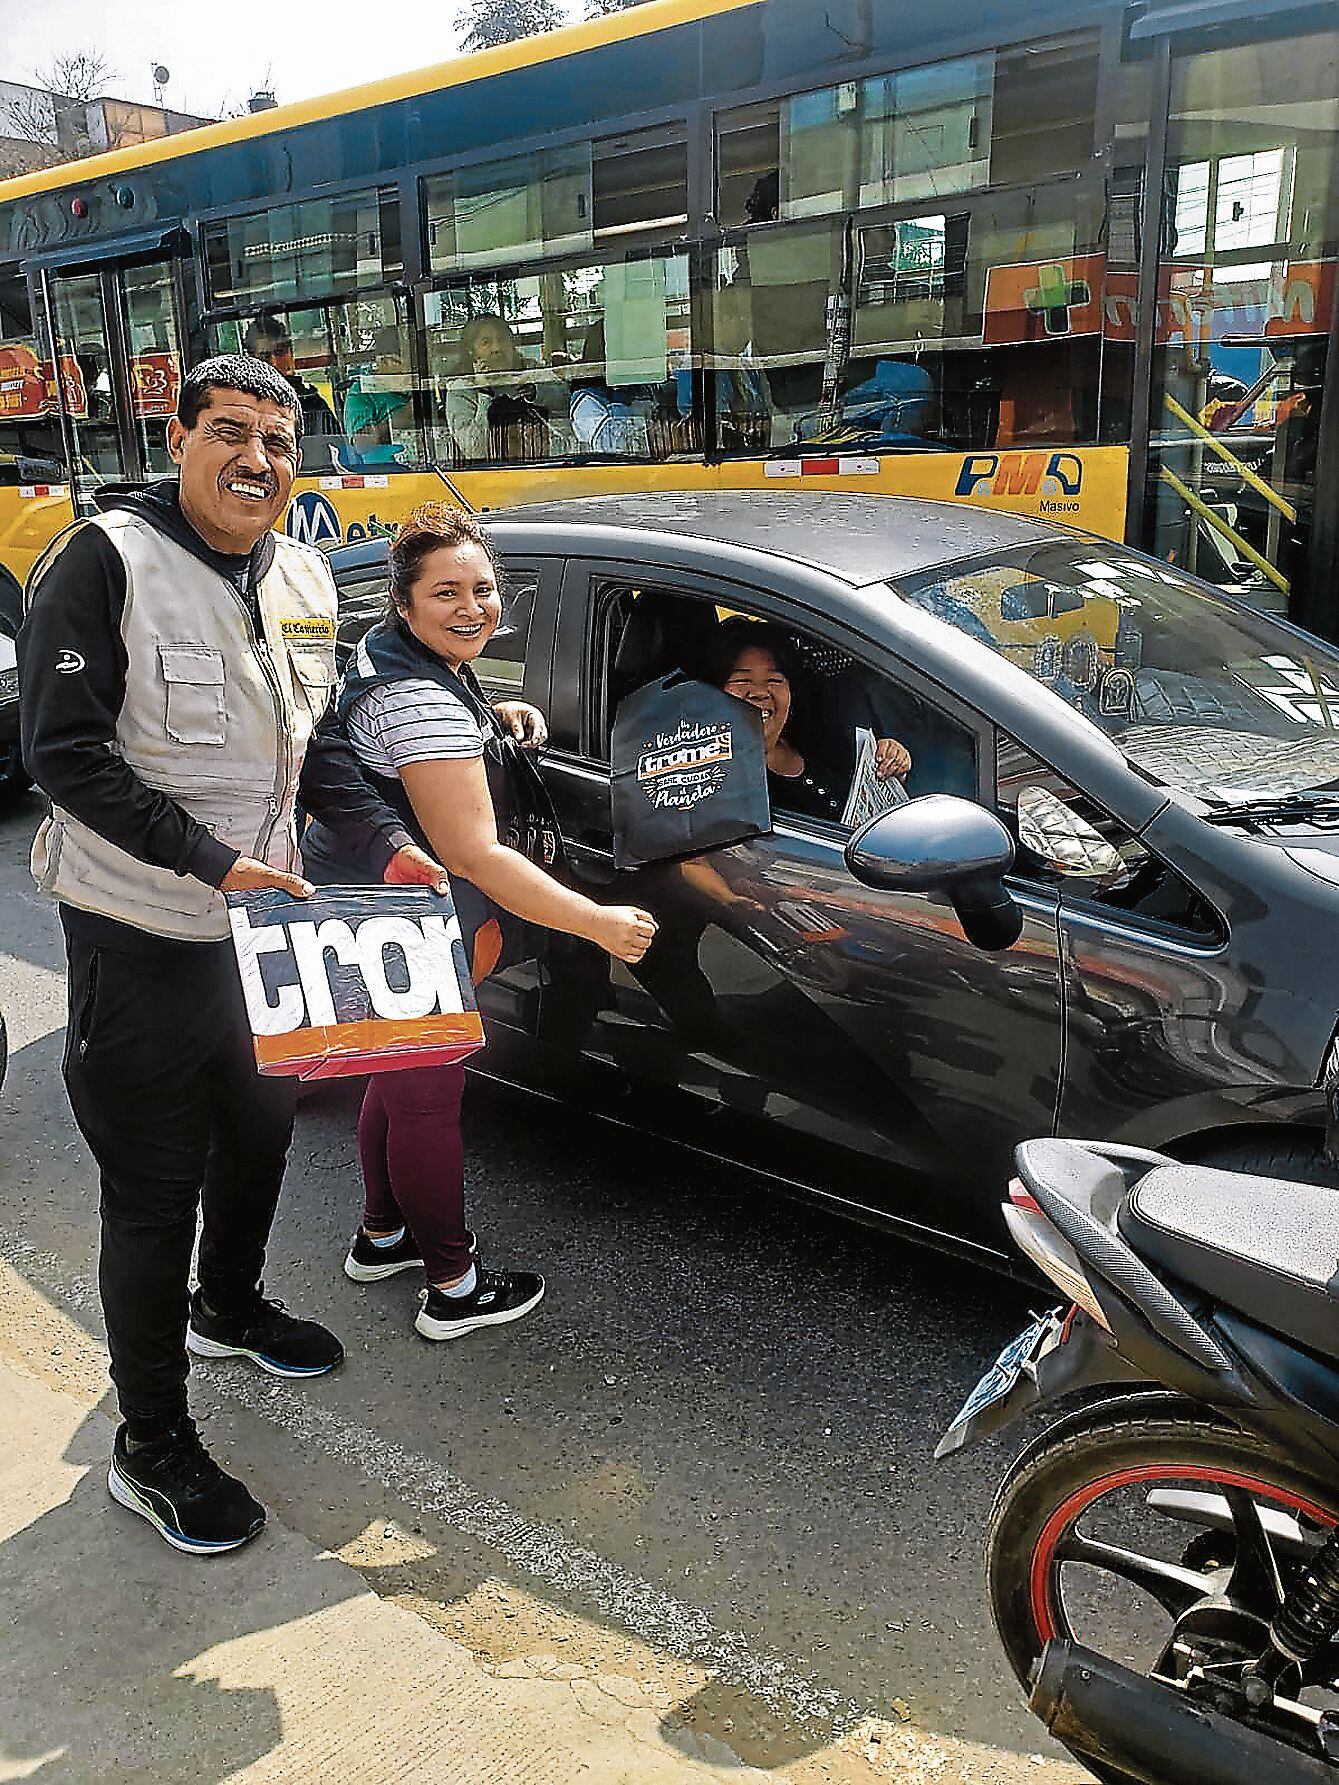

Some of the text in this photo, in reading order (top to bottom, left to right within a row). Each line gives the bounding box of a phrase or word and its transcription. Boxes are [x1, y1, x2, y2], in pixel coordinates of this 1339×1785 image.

[1039, 499, 1080, 513] Masivo
[656, 723, 717, 748] Verdadero
[655, 785, 716, 808] Planeta
